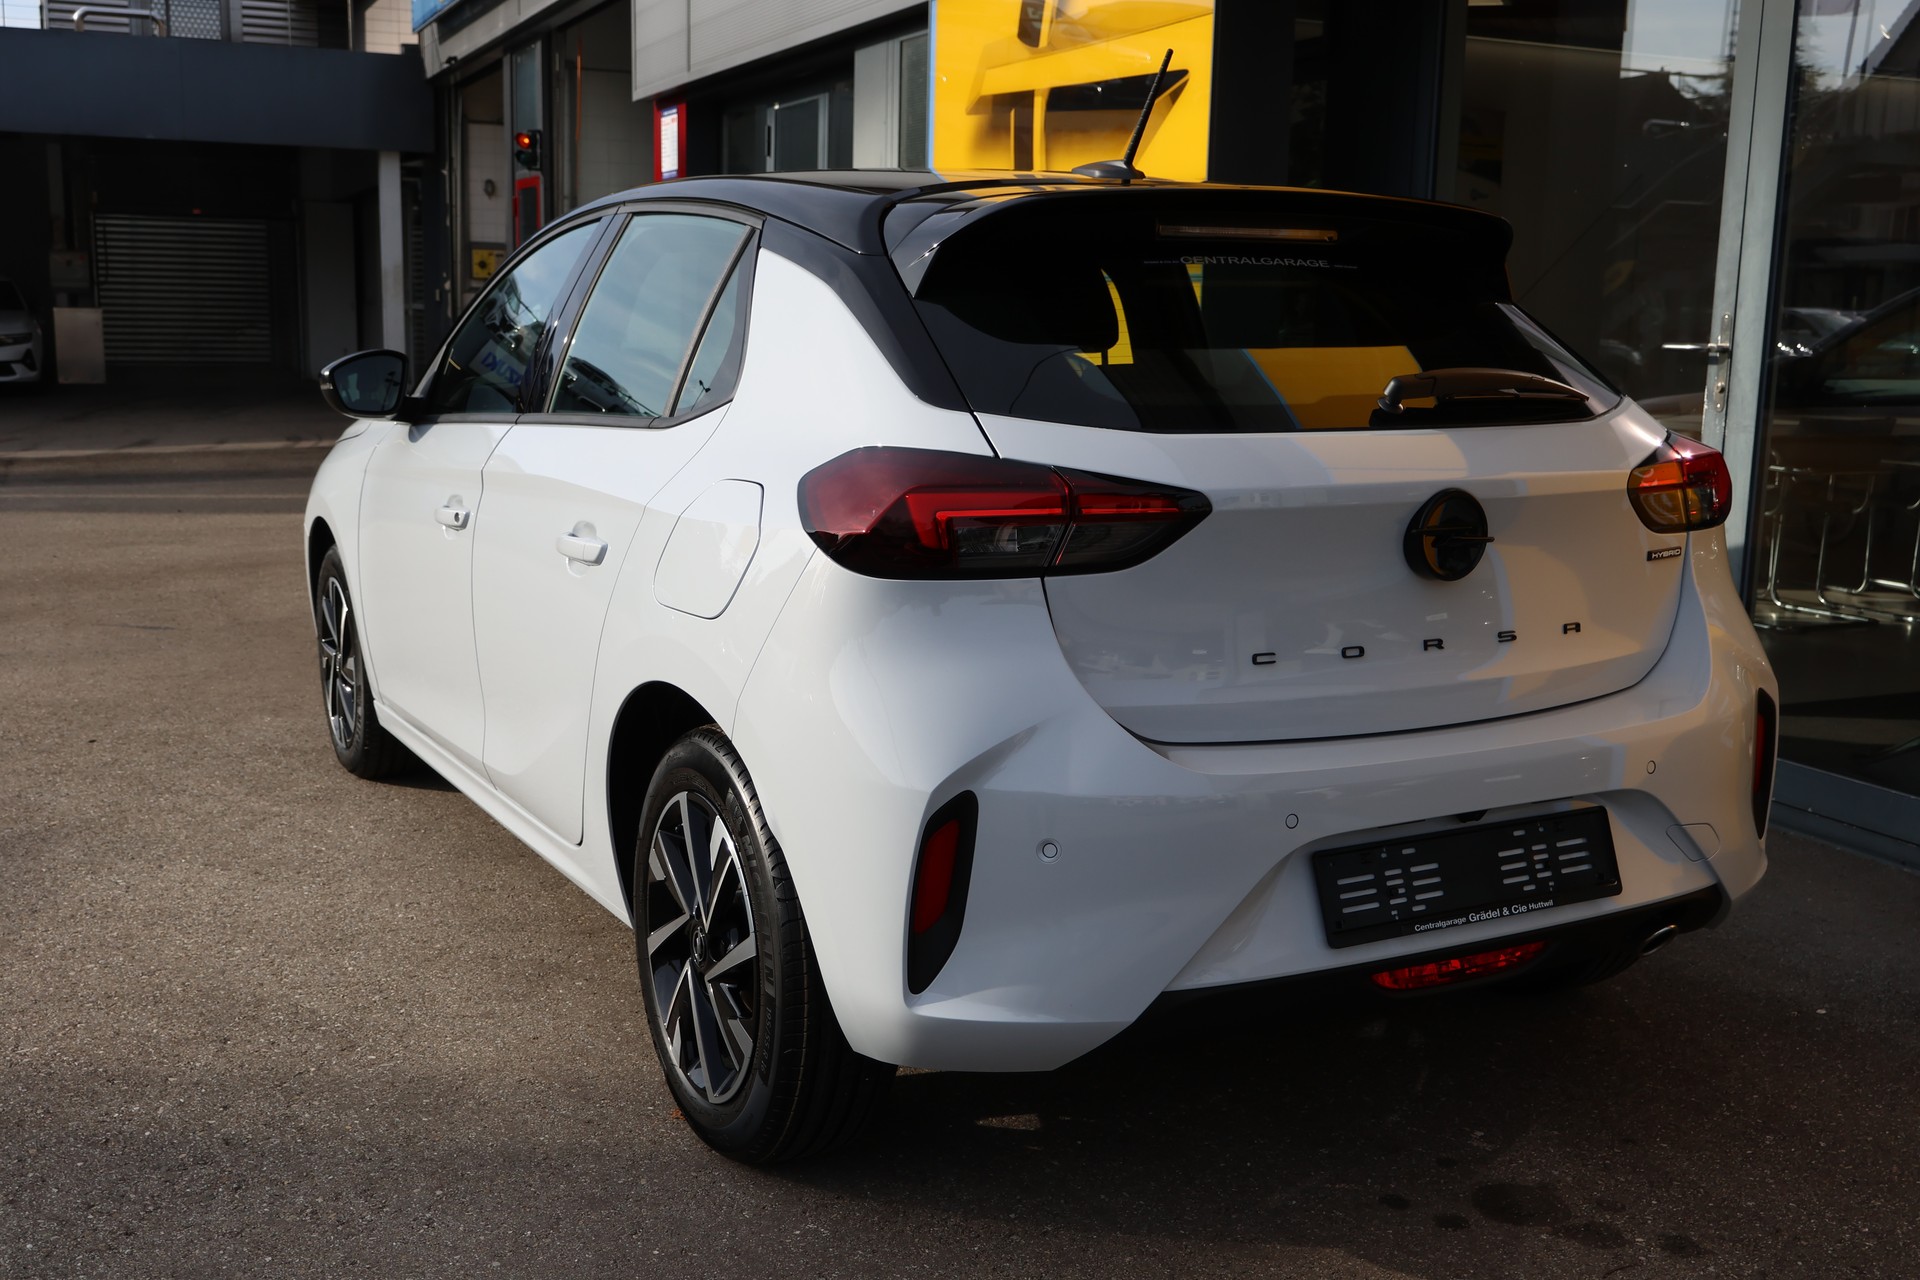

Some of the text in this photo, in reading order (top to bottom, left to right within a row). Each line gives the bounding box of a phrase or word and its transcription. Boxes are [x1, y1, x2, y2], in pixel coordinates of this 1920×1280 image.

[1180, 255, 1330, 268] CENTRALGARAGE
[1251, 621, 1582, 666] CORSA
[1414, 899, 1554, 932] Centralgarage Grädel & Cie Huttwil
[763, 1006, 773, 1048] 195/55
